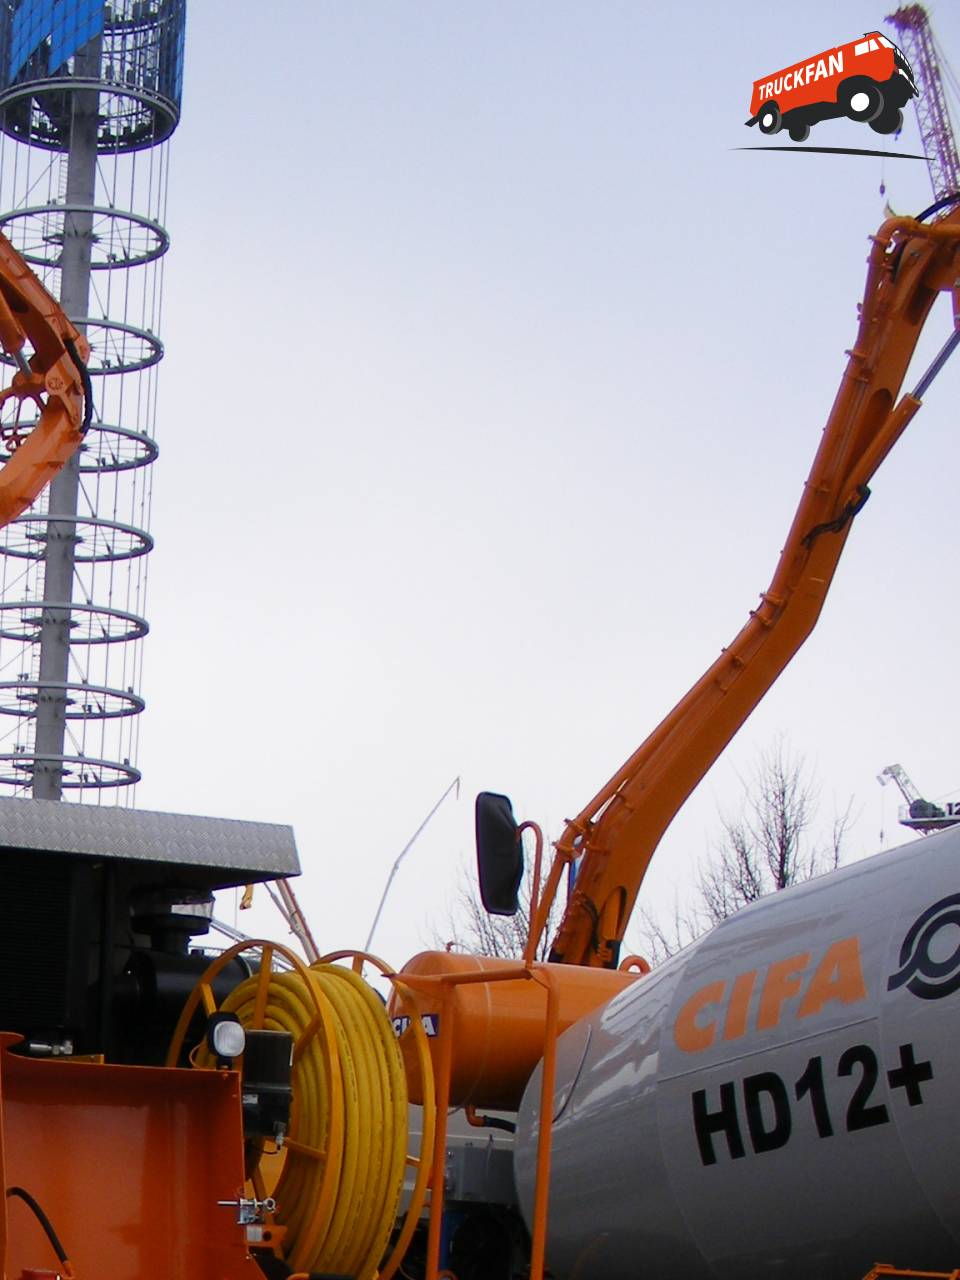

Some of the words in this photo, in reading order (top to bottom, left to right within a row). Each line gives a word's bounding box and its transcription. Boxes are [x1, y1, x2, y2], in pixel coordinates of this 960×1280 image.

[392, 1015, 436, 1037] CIA
[673, 935, 869, 1055] CIFA
[691, 1042, 934, 1167] HD12+
